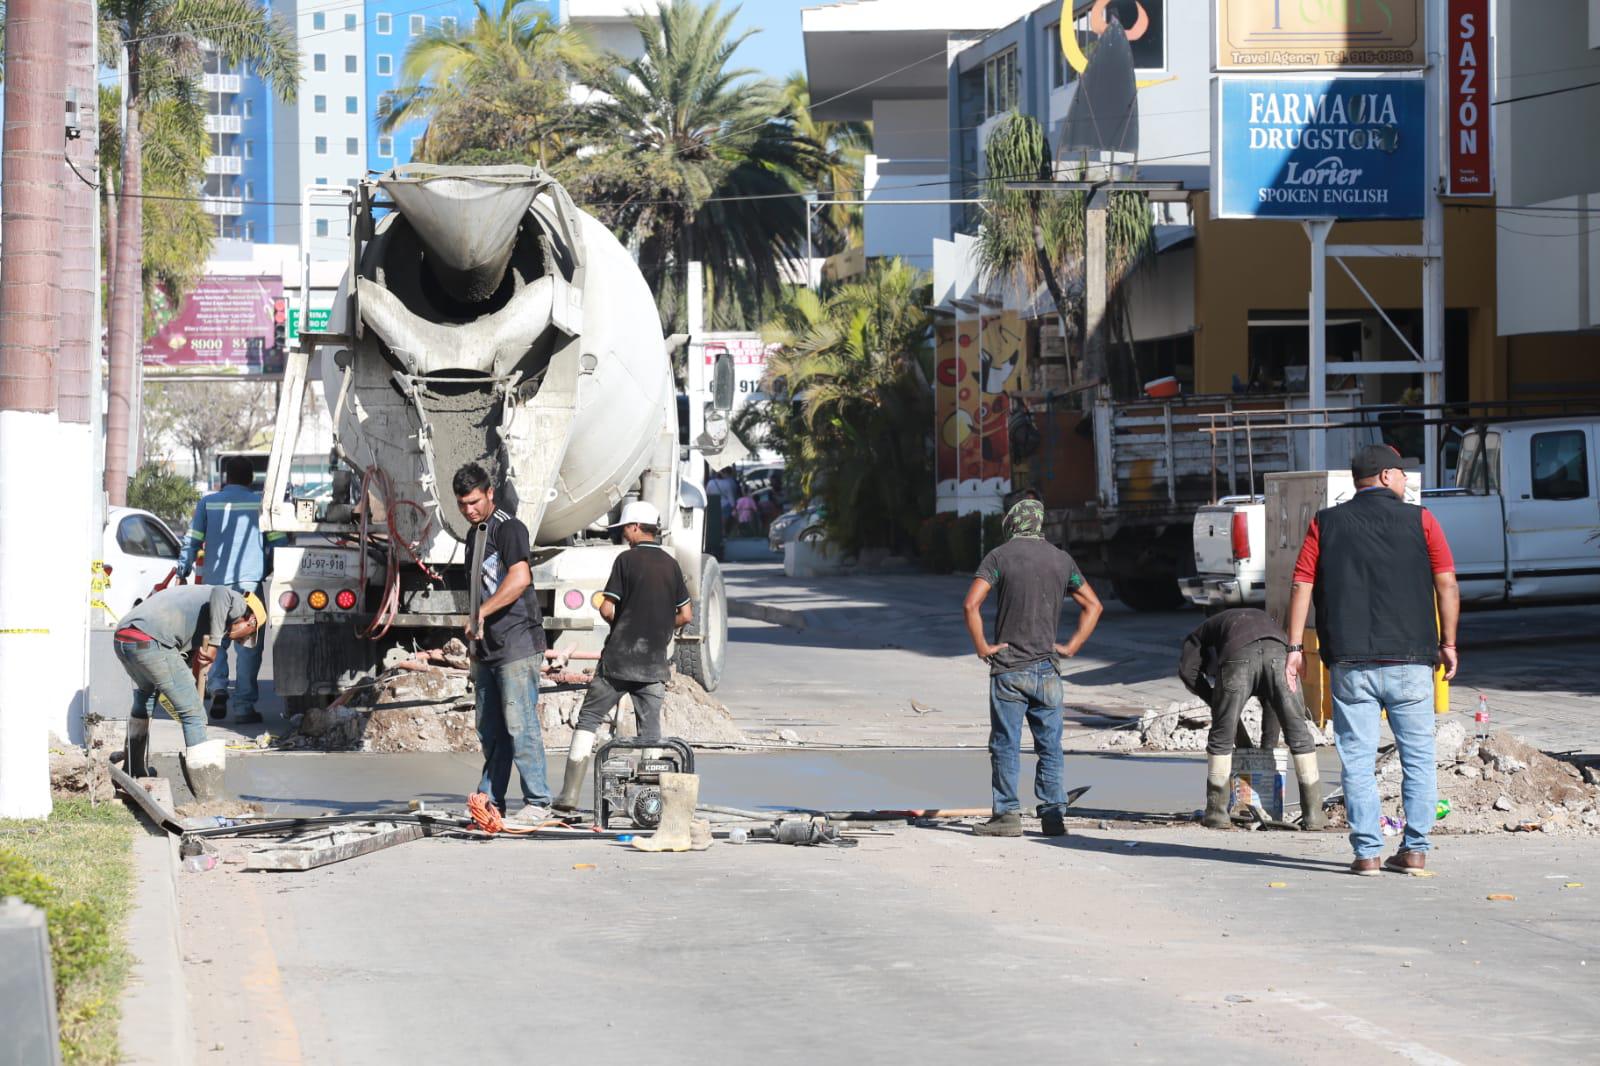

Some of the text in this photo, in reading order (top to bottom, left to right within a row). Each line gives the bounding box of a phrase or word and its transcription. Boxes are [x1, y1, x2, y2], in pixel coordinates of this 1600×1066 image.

[1232, 51, 1270, 63] Travel
[1273, 51, 1319, 65] Agency
[1325, 51, 1348, 63] Tel.
[1459, 13, 1478, 155] SAZÓN
[1249, 128, 1399, 151] DRUGSTOR
[1284, 157, 1363, 185] Lorier
[1258, 188, 1388, 204] SPOKEN ENGLISH
